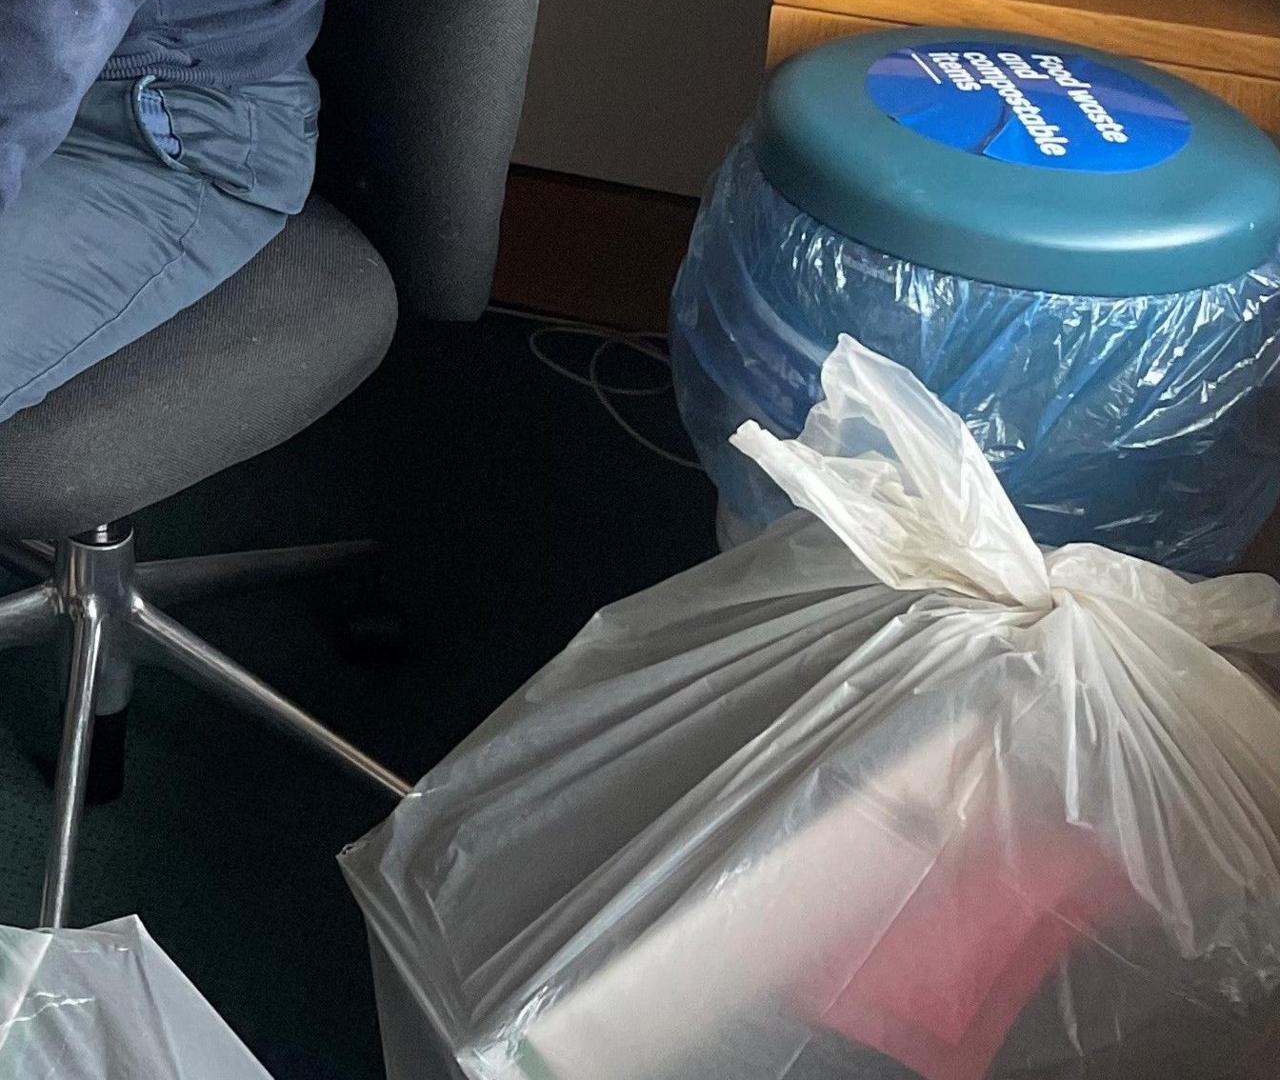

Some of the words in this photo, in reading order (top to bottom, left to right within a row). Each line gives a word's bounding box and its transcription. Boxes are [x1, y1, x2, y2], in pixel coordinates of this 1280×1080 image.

[928, 51, 982, 92] items
[998, 52, 1049, 81] and
[1031, 53, 1091, 88] Food
[1067, 88, 1129, 144] waste
[963, 52, 1067, 156] compostable
